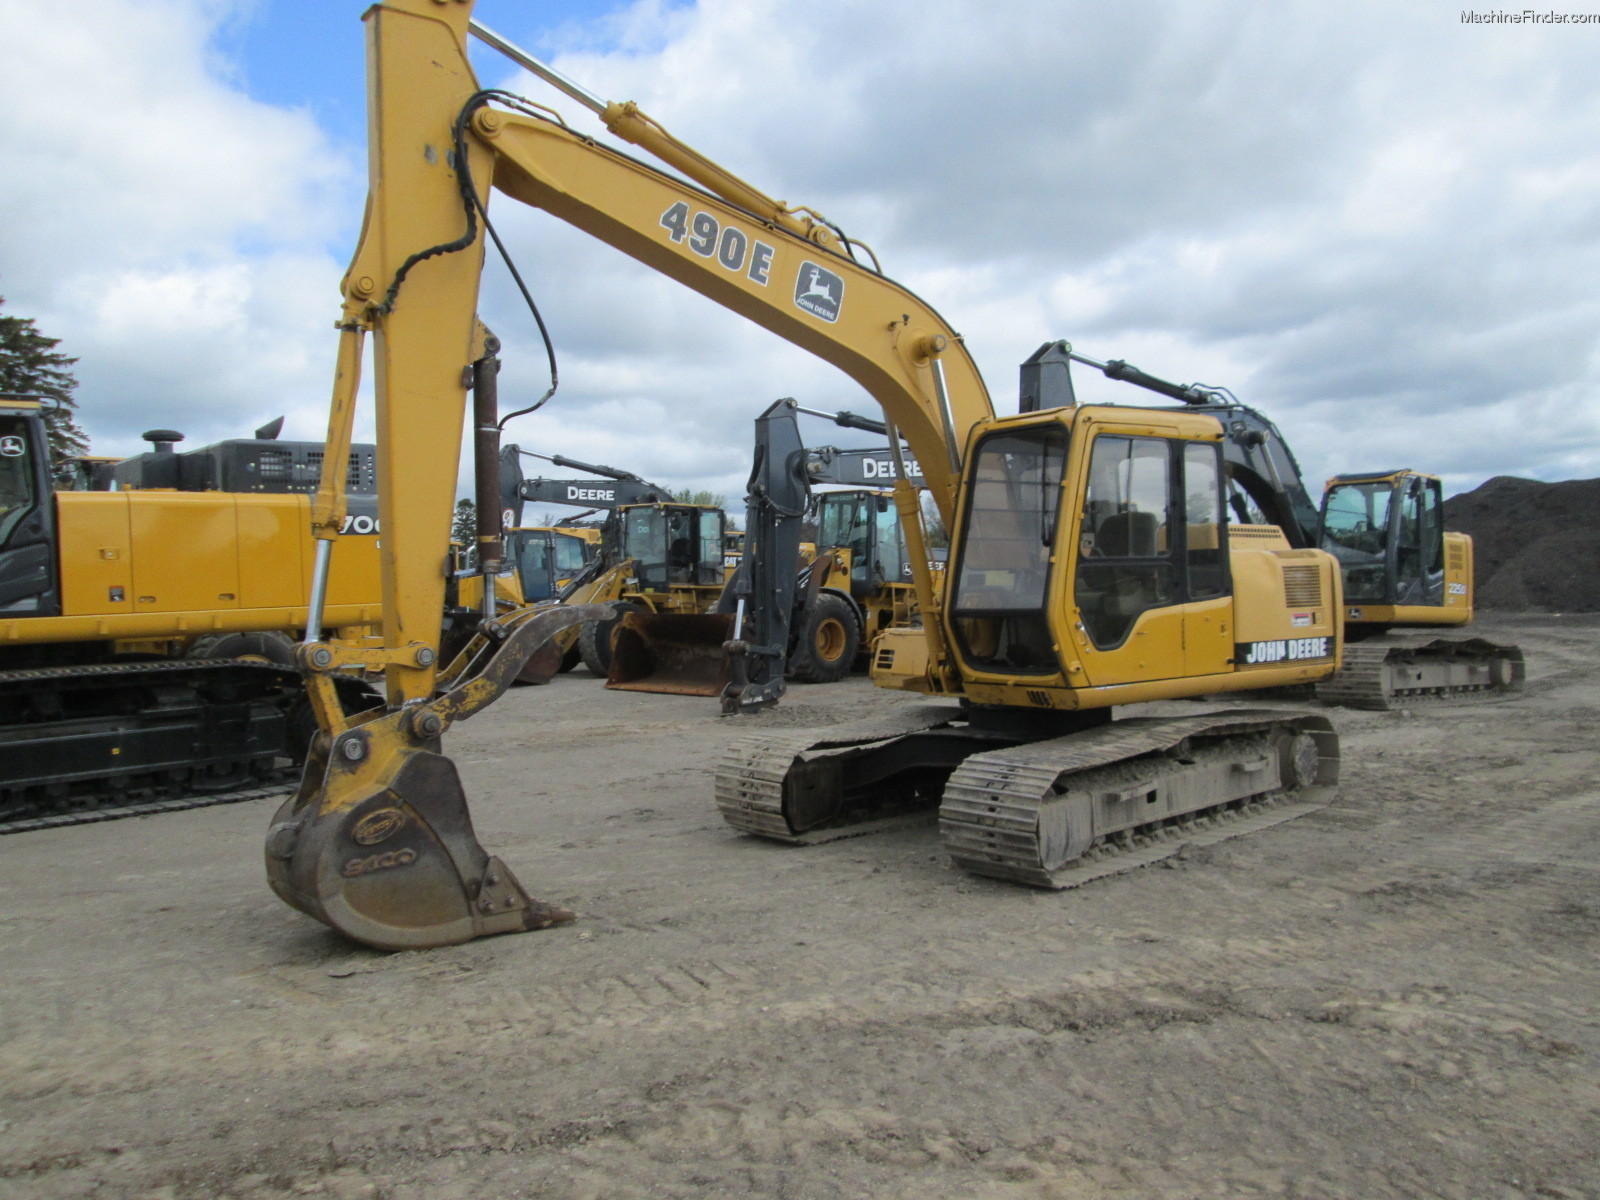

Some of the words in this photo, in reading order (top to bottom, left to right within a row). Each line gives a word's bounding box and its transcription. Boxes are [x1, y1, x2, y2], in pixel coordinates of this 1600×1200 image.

[659, 201, 775, 287] 490E
[796, 298, 814, 310] JOHN
[813, 305, 835, 320] DEERE
[567, 486, 615, 501] DEERE
[1246, 640, 1287, 664] JOHN
[1288, 637, 1328, 660] DEERE
